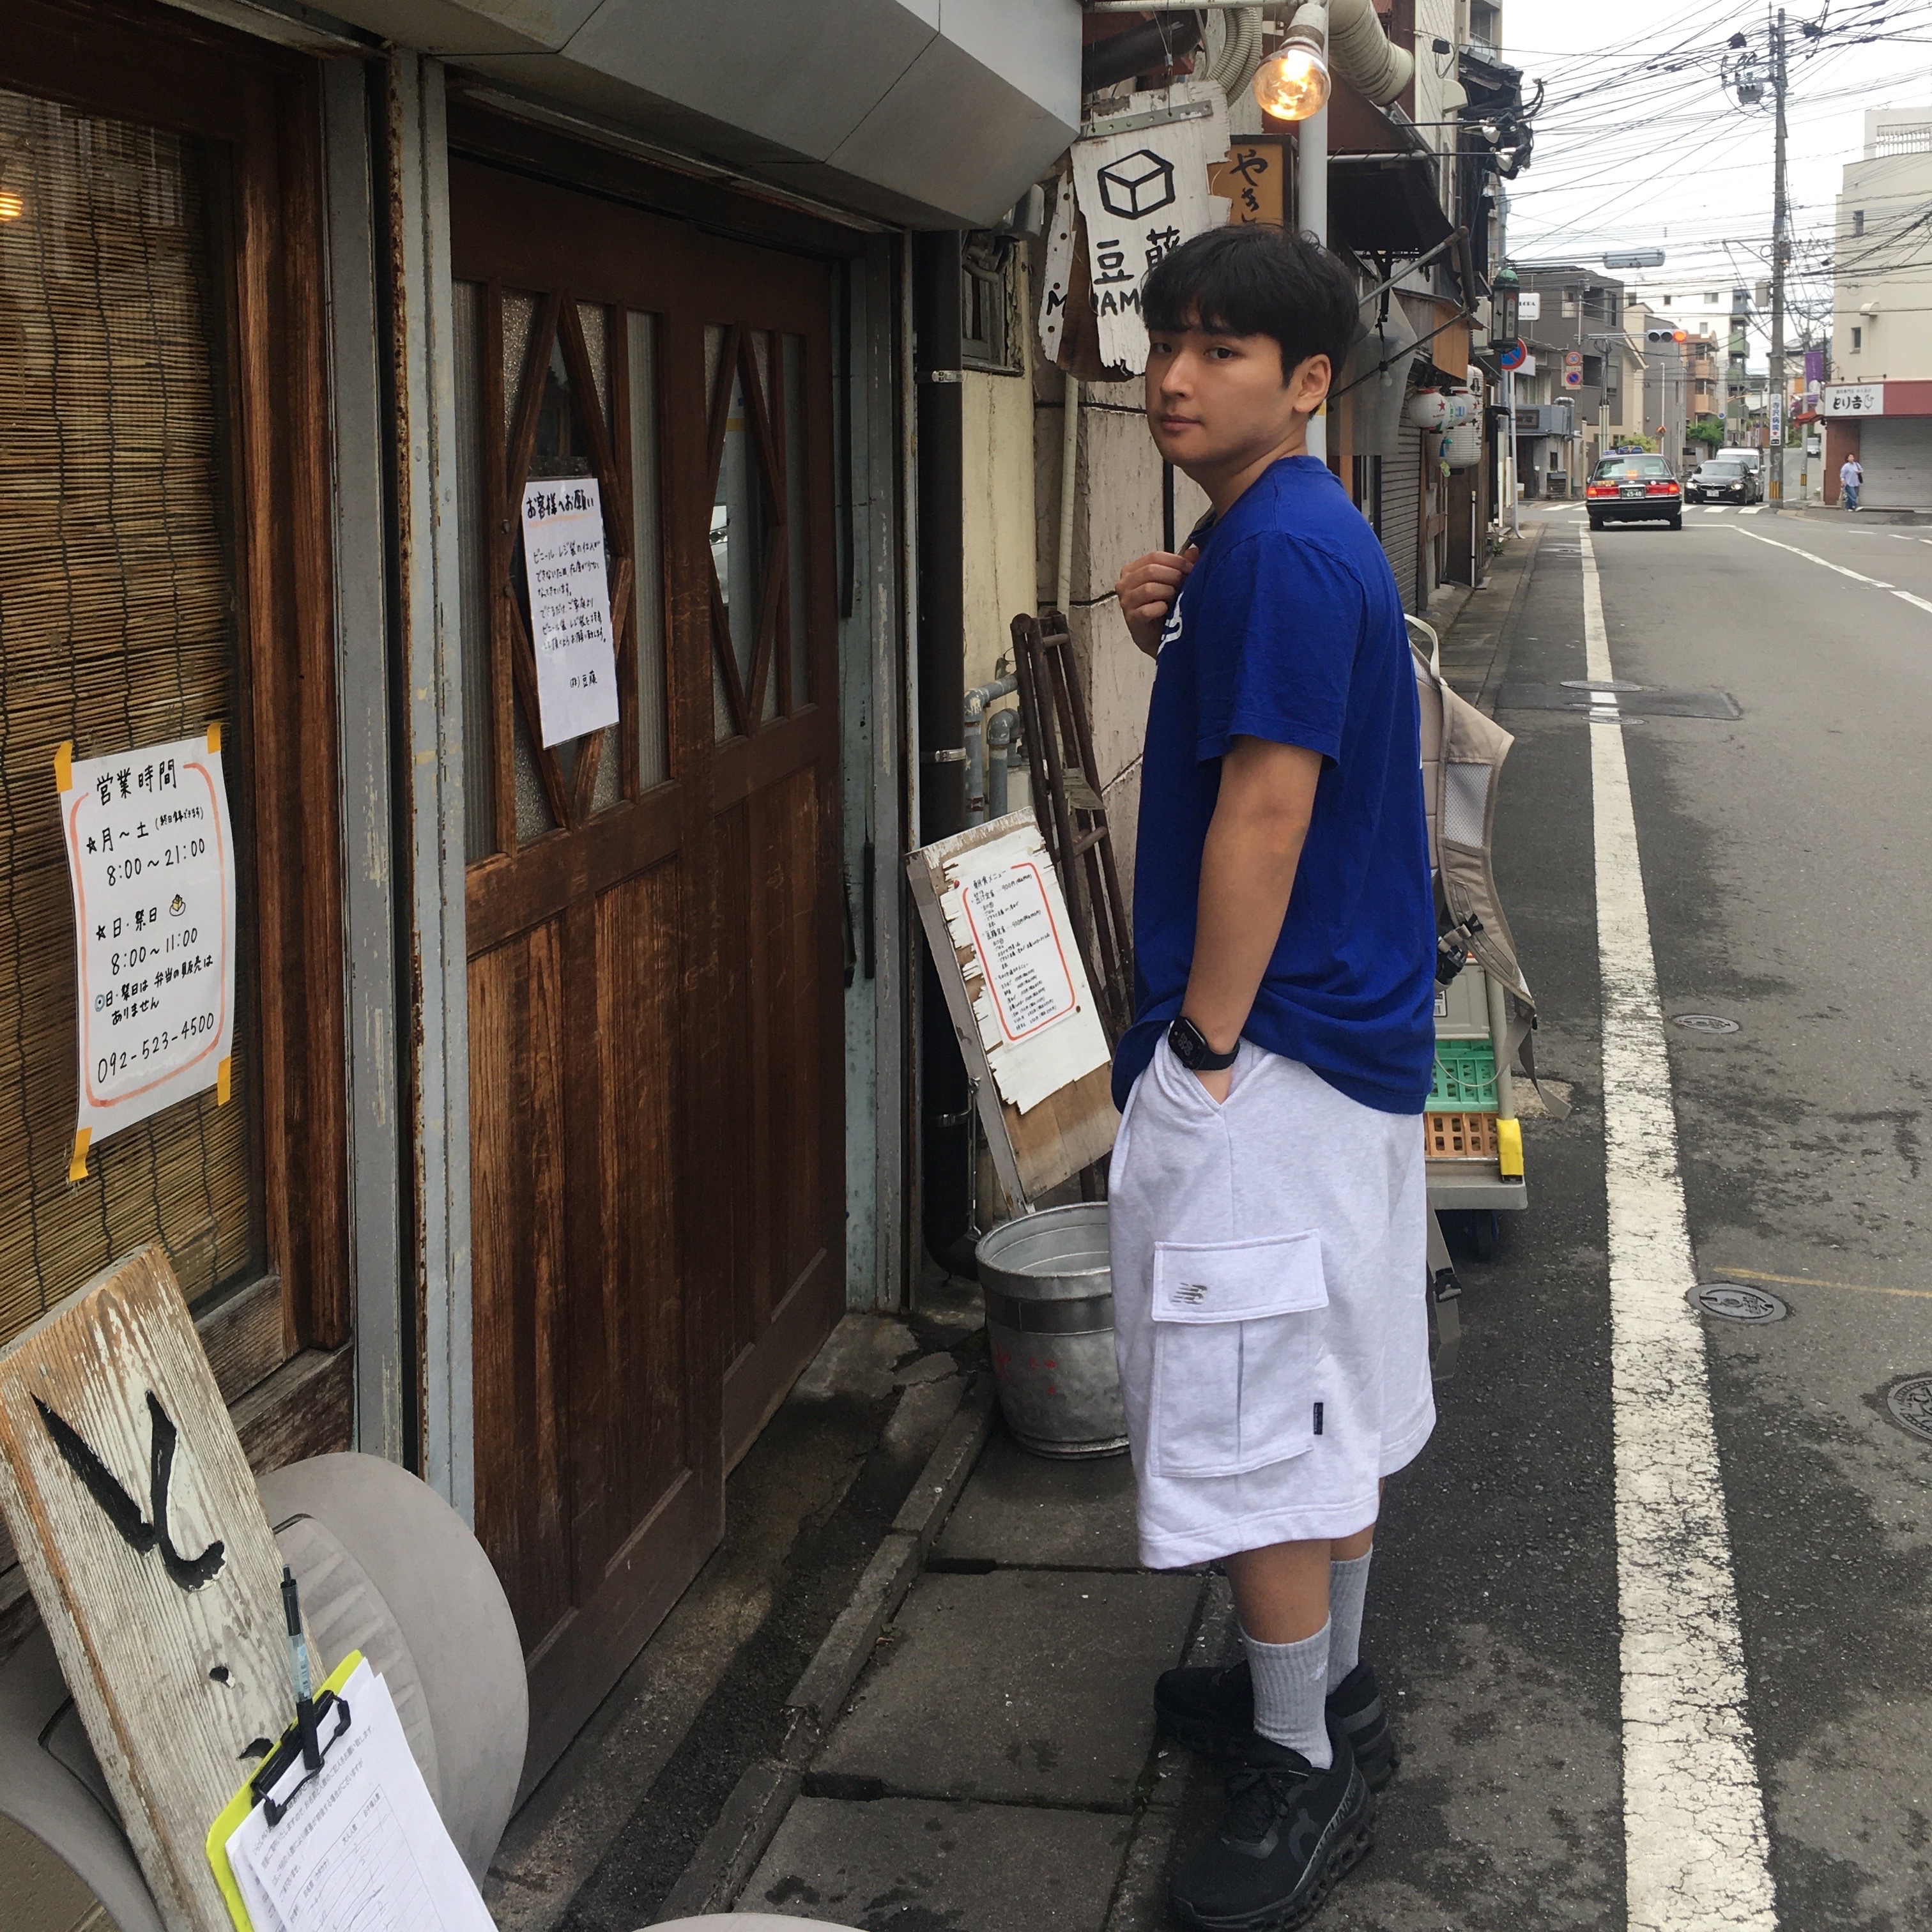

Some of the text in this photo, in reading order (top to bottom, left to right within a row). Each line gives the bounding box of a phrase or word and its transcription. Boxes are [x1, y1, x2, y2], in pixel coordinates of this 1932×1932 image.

[1833, 395, 1862, 410] とり吉
[526, 489, 594, 519] お客様へお願い
[97, 758, 177, 806] 営業時間
[112, 997, 159, 1025] ありません
[97, 1012, 215, 1084] 092-523-4500
